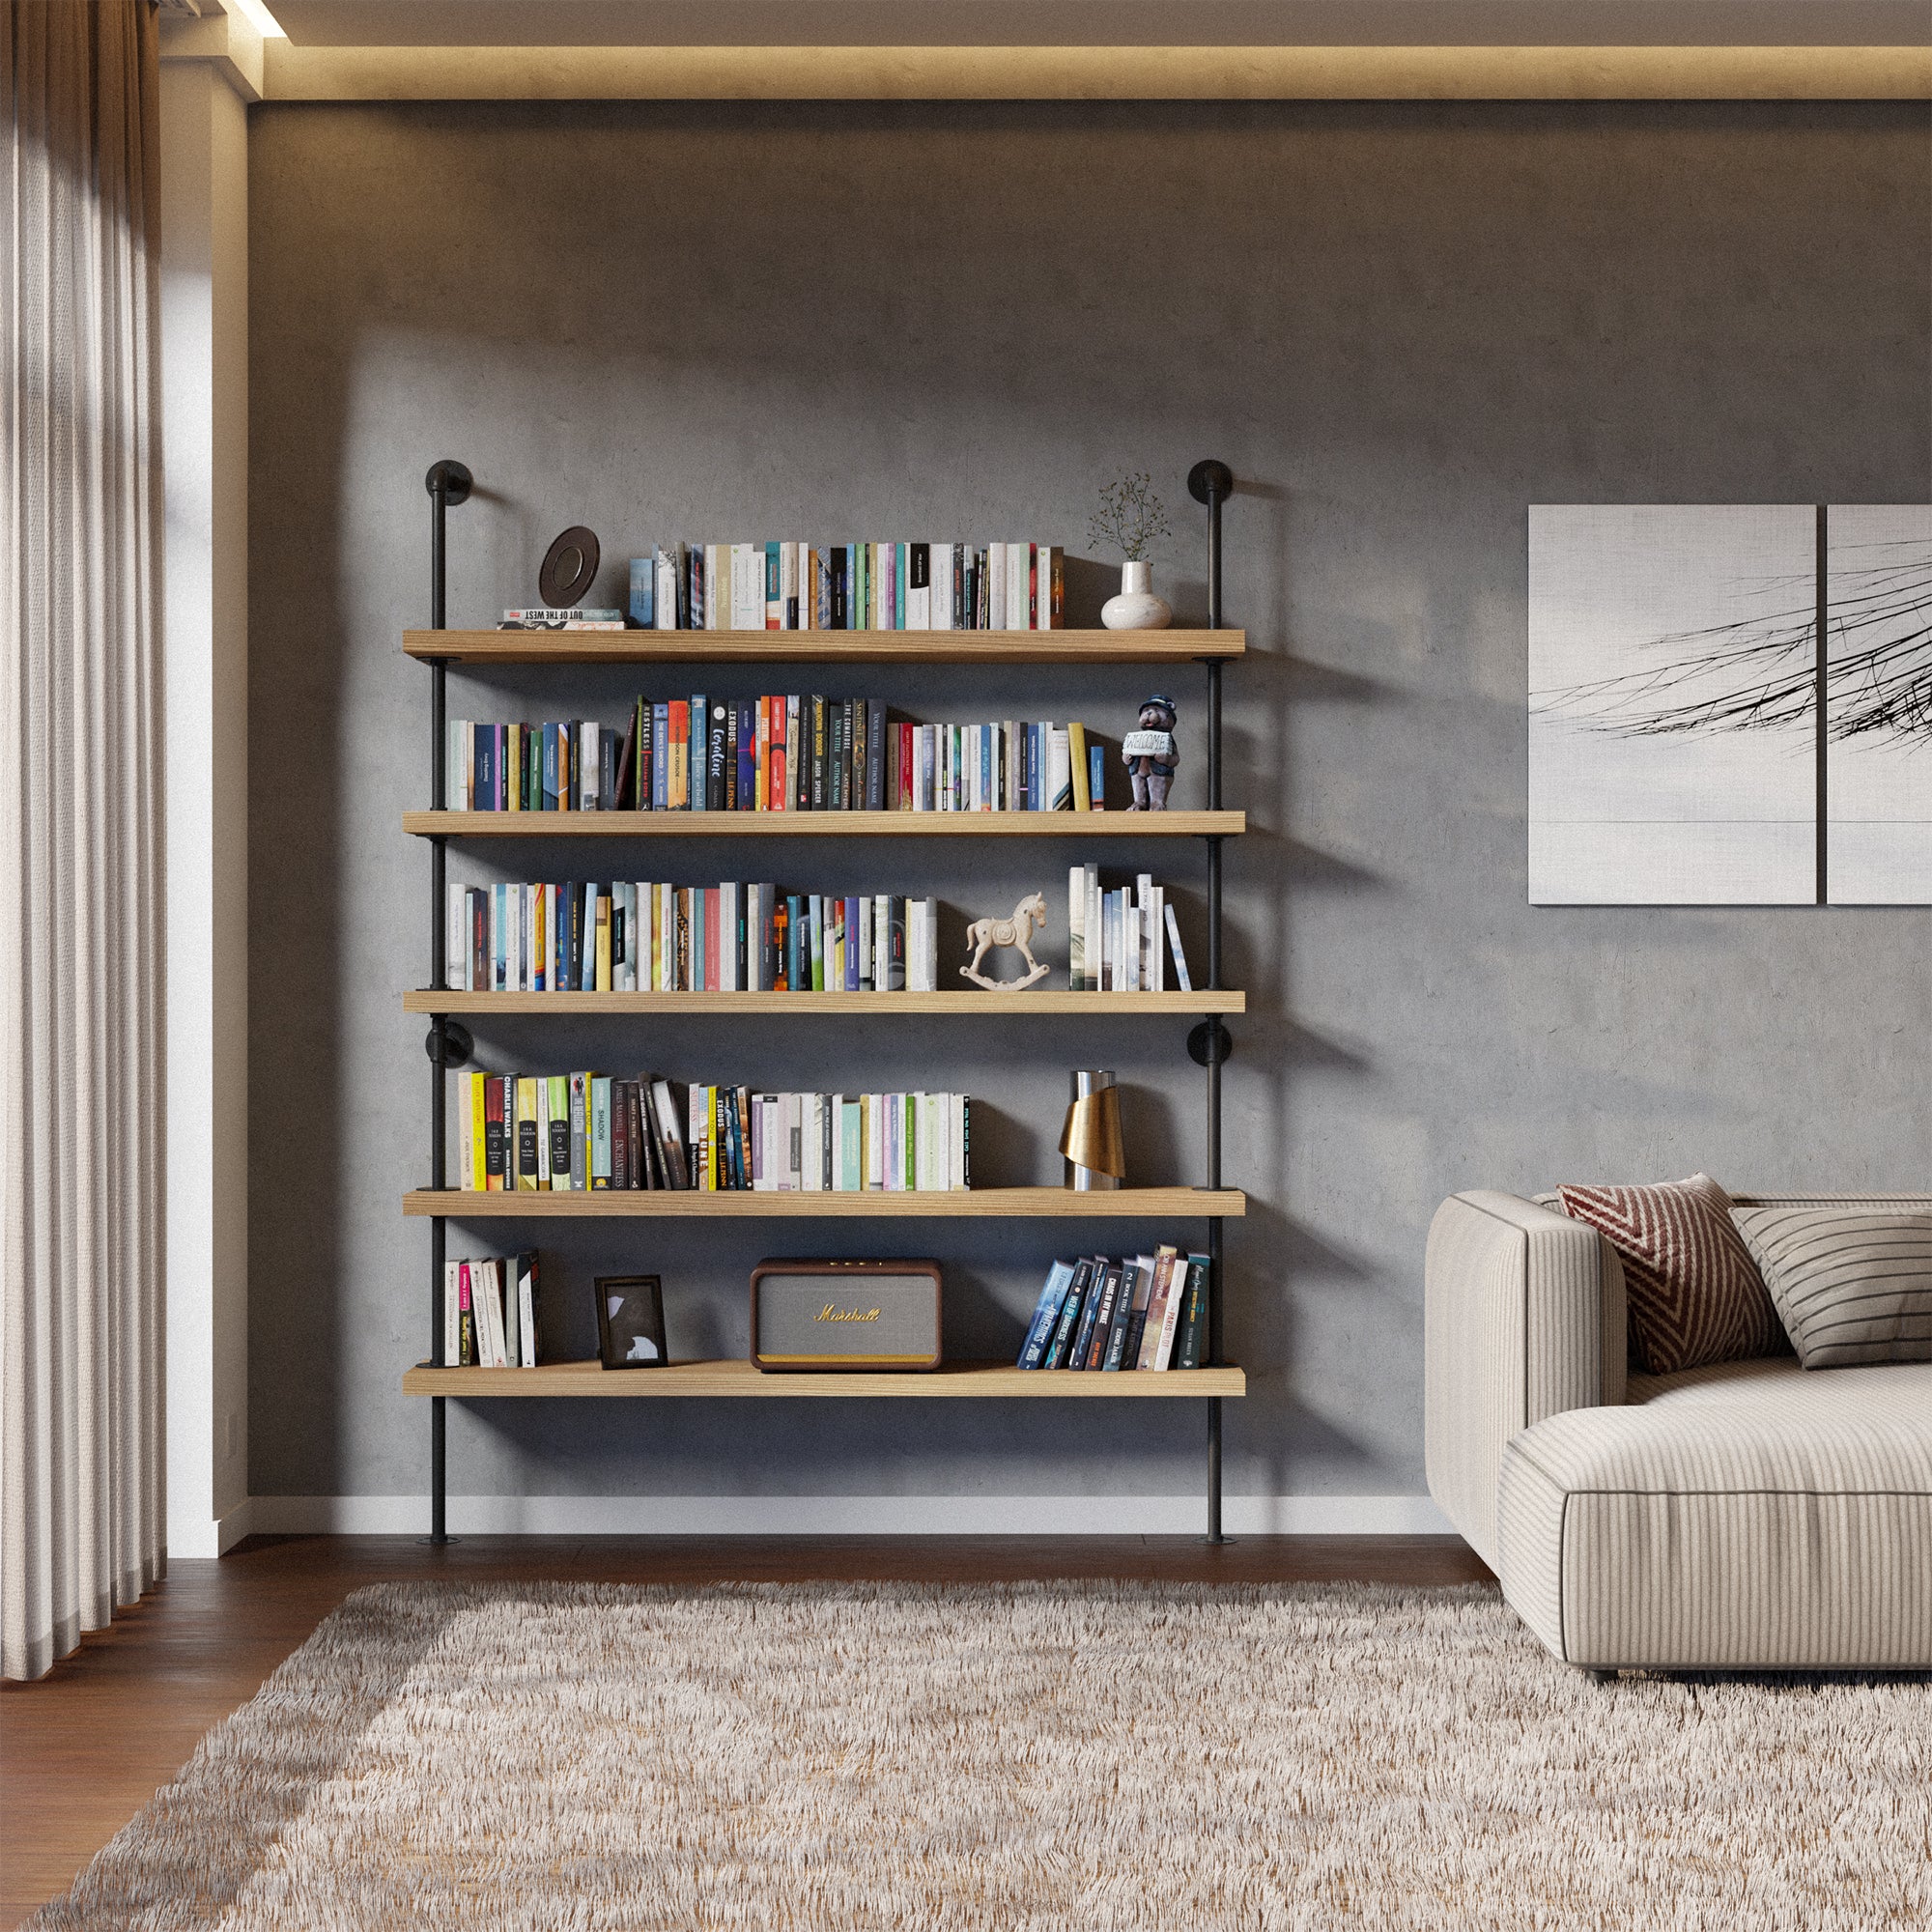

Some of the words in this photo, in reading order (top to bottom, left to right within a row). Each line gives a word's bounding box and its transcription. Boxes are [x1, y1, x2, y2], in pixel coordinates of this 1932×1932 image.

[526, 611, 545, 619] WEST
[546, 611, 558, 619] THE
[559, 611, 568, 619] OF
[570, 611, 582, 619] OUT
[1126, 734, 1165, 750] WELCOME
[711, 728, 724, 778] Coraline
[1159, 1264, 1168, 1274] ANN
[1104, 1278, 1117, 1295] CHAOS
[1122, 1284, 1130, 1298] BOOK
[1155, 1274, 1167, 1300] STEPHENS
[1067, 1295, 1079, 1307] WEB
[1101, 1301, 1112, 1310] MY
[1120, 1298, 1128, 1313] TITLE
[813, 1303, 882, 1321] Marshall
[1098, 1310, 1110, 1324] WAKE
[1034, 1304, 1057, 1344] AWAKENINGS
[1057, 1315, 1074, 1341] DARKNESS
[1164, 1311, 1175, 1331] PARIS
[1113, 1328, 1123, 1346] EDDIE
[1162, 1332, 1171, 1348] PLOT
[1110, 1346, 1121, 1364] JAKES
